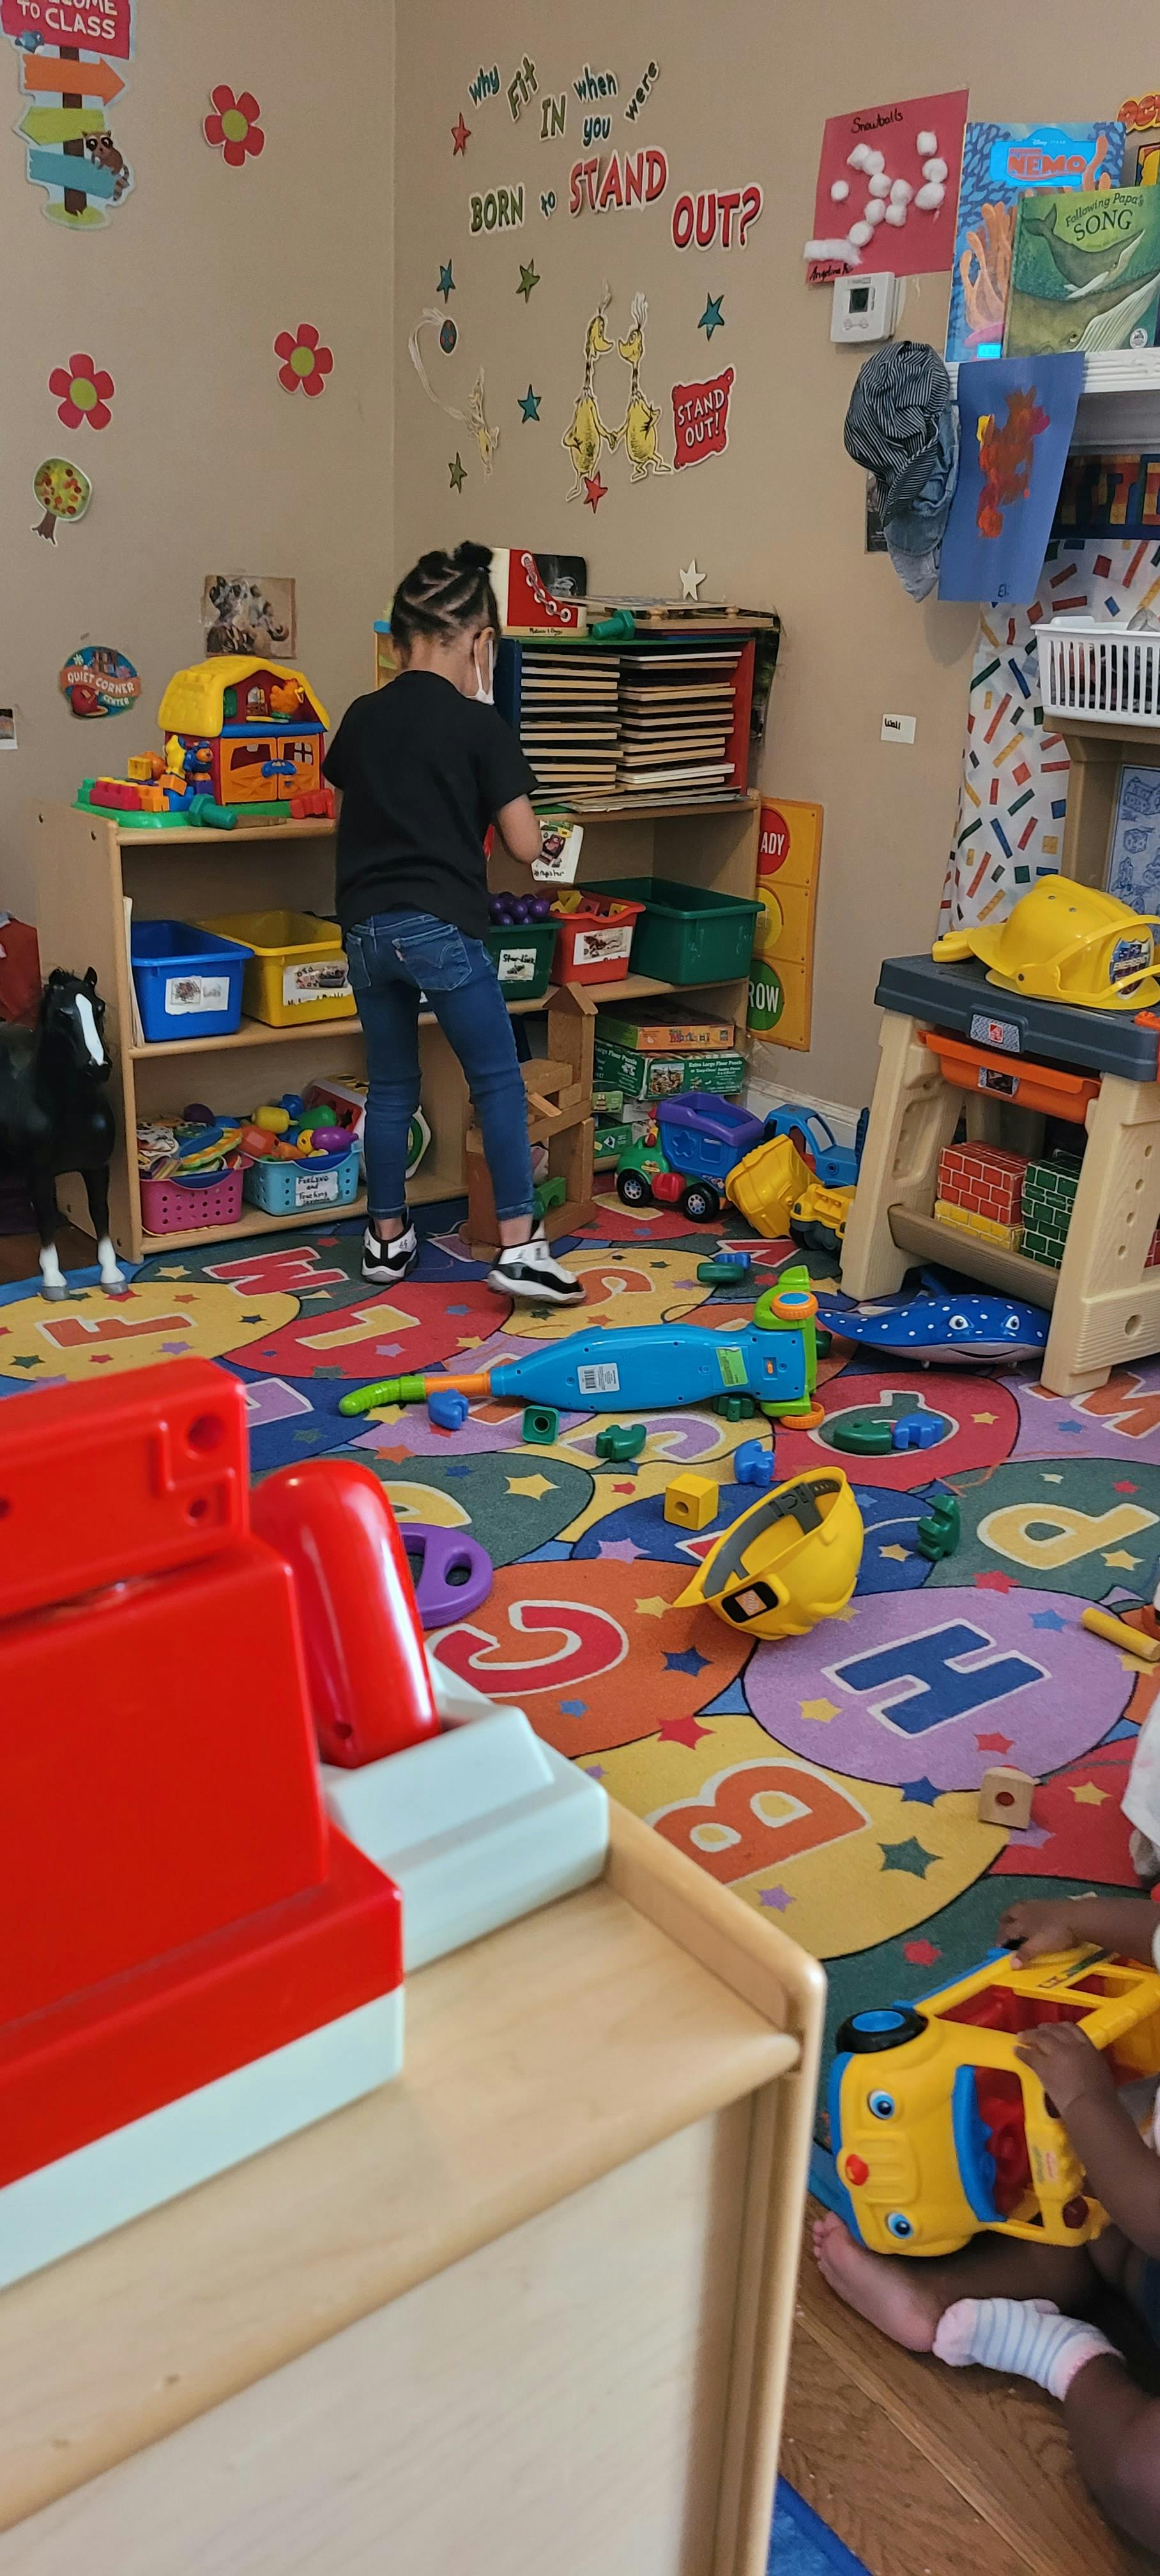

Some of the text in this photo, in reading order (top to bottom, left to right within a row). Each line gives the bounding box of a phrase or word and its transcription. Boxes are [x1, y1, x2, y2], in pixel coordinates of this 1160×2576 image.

[17, 0, 116, 40] TO CLASS
[469, 65, 500, 107] why
[574, 66, 617, 100] when
[625, 63, 657, 120] were
[540, 95, 566, 138] IN
[583, 117, 611, 146] you
[851, 108, 903, 134] Snowballs
[1007, 155, 1087, 176] NEMO
[471, 151, 761, 248] BORN to STAND OUT?
[1065, 192, 1145, 227] Following Papa's
[1073, 209, 1133, 241] SONG
[678, 389, 724, 425] STAND
[685, 411, 719, 447] OUT!
[67, 671, 135, 694] QUIET CORNER
[103, 694, 130, 706] CENTER
[760, 832, 786, 856] ADY
[748, 982, 779, 1013] ROW
[35, 1313, 197, 1349] F
[977, 1503, 1159, 1570] P
[425, 1600, 629, 1697] C
[820, 1618, 1053, 1739] H
[645, 1757, 873, 1887] B
